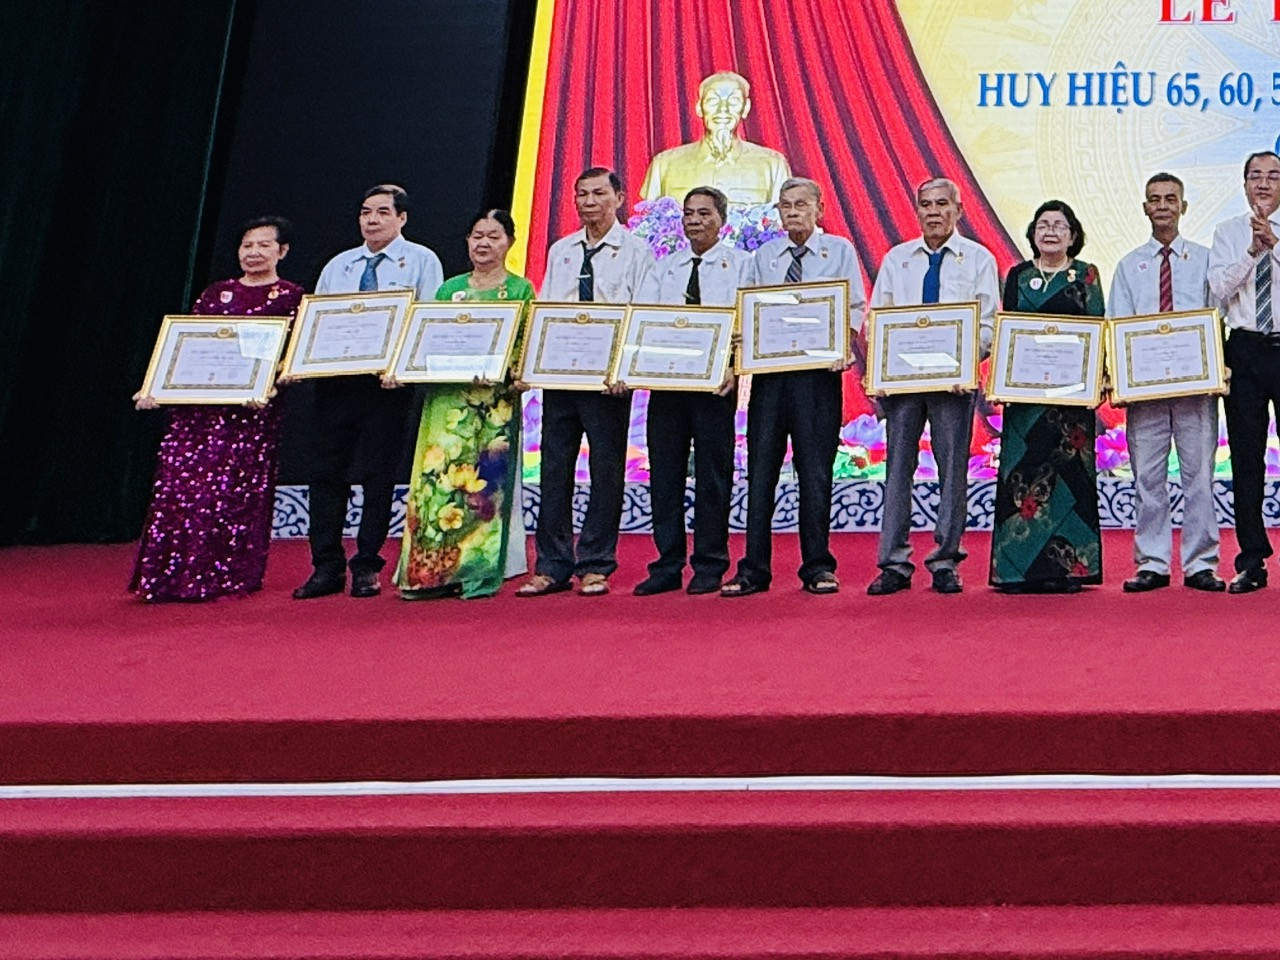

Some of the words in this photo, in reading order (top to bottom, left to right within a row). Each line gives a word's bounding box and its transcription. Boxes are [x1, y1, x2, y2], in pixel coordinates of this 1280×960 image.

[978, 73, 1056, 108] HUY
[1066, 61, 1156, 114] HIỆU
[1166, 72, 1211, 112] 65,
[1219, 72, 1264, 112] 60,
